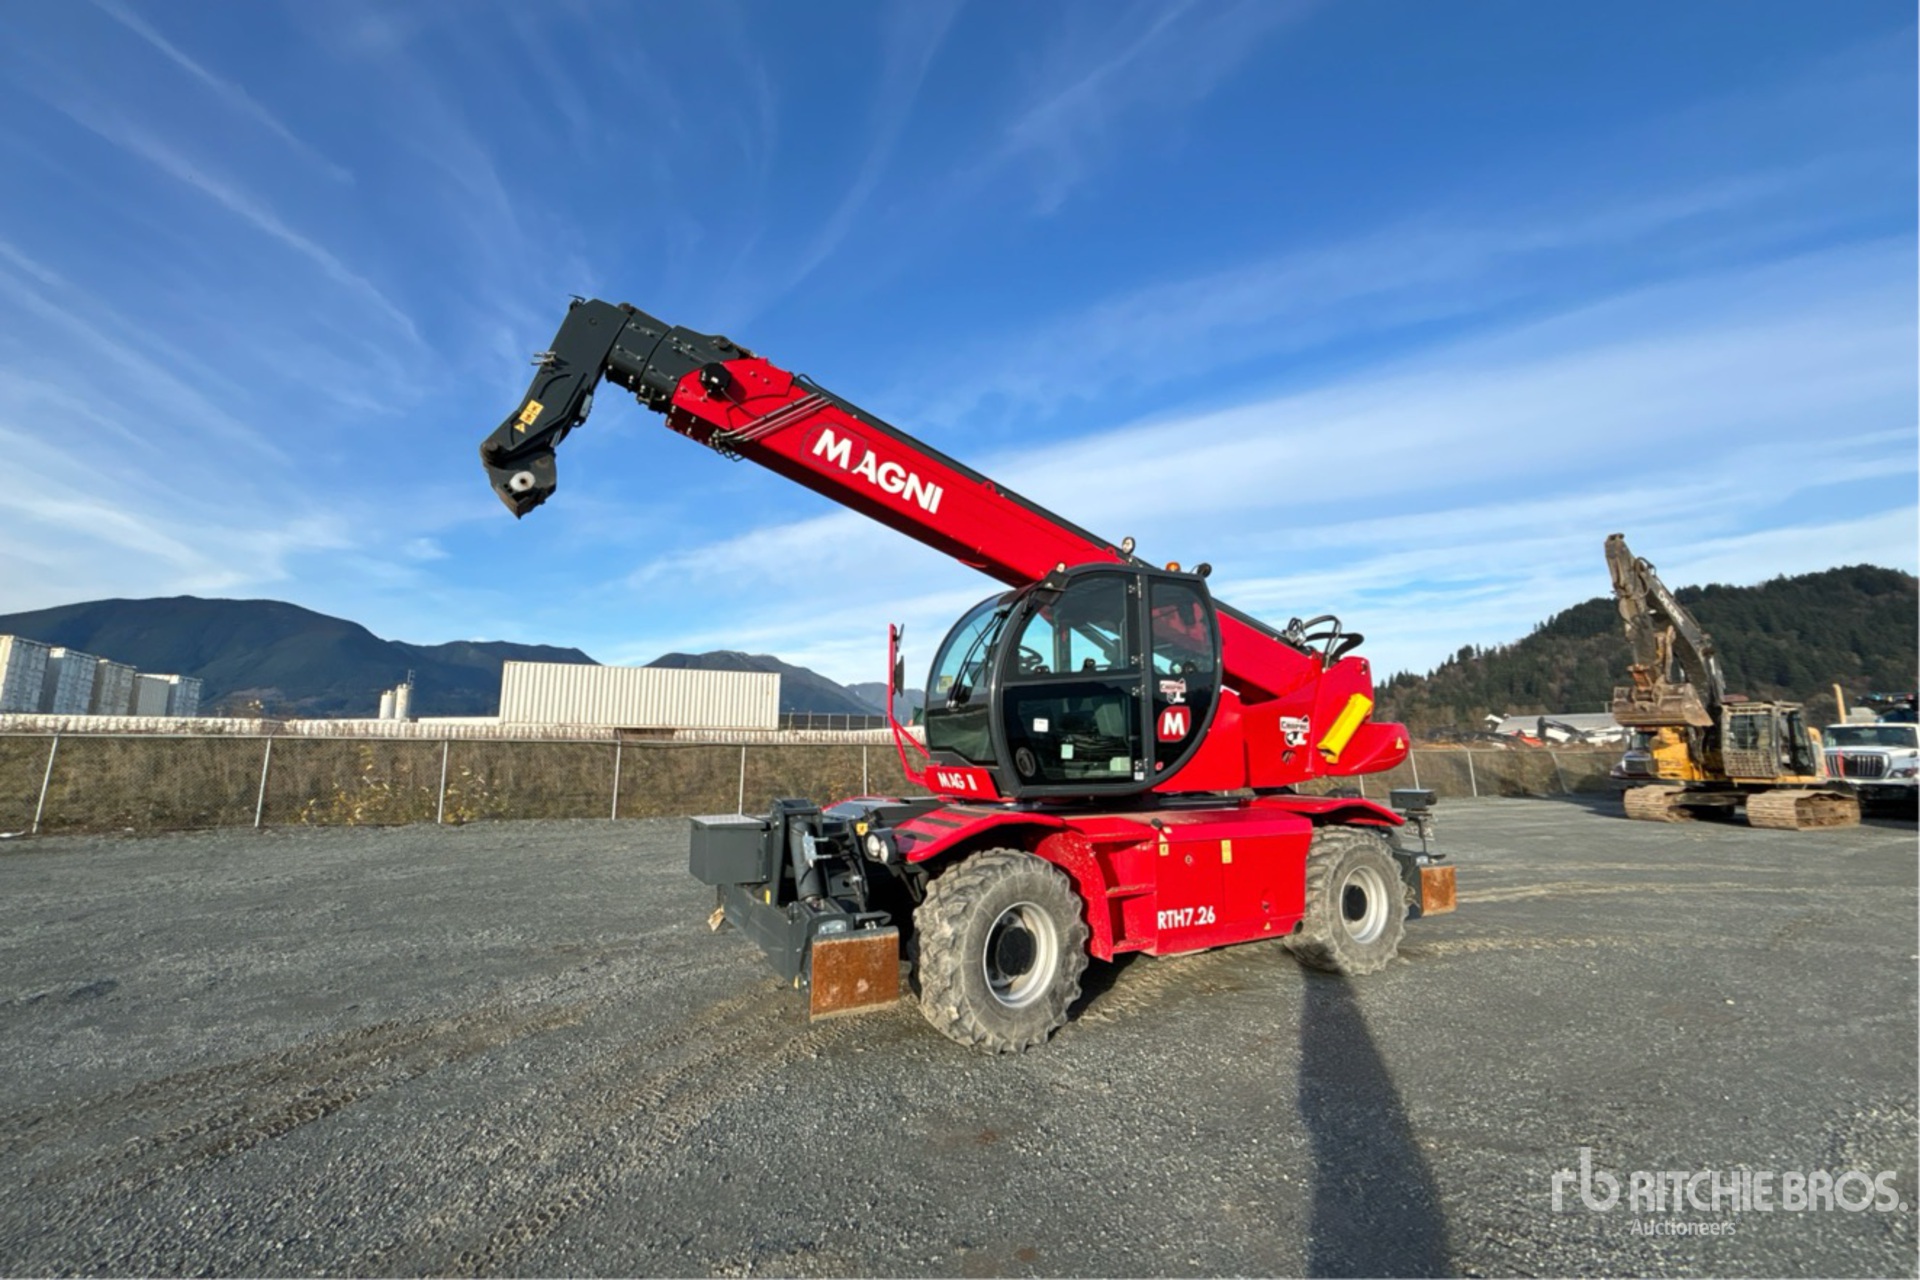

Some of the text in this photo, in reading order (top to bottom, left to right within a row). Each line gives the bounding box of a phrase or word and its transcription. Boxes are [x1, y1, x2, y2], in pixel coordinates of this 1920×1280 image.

[812, 428, 944, 515] MAGNI
[1163, 712, 1185, 736] M
[1157, 905, 1217, 930] RTH7.26
